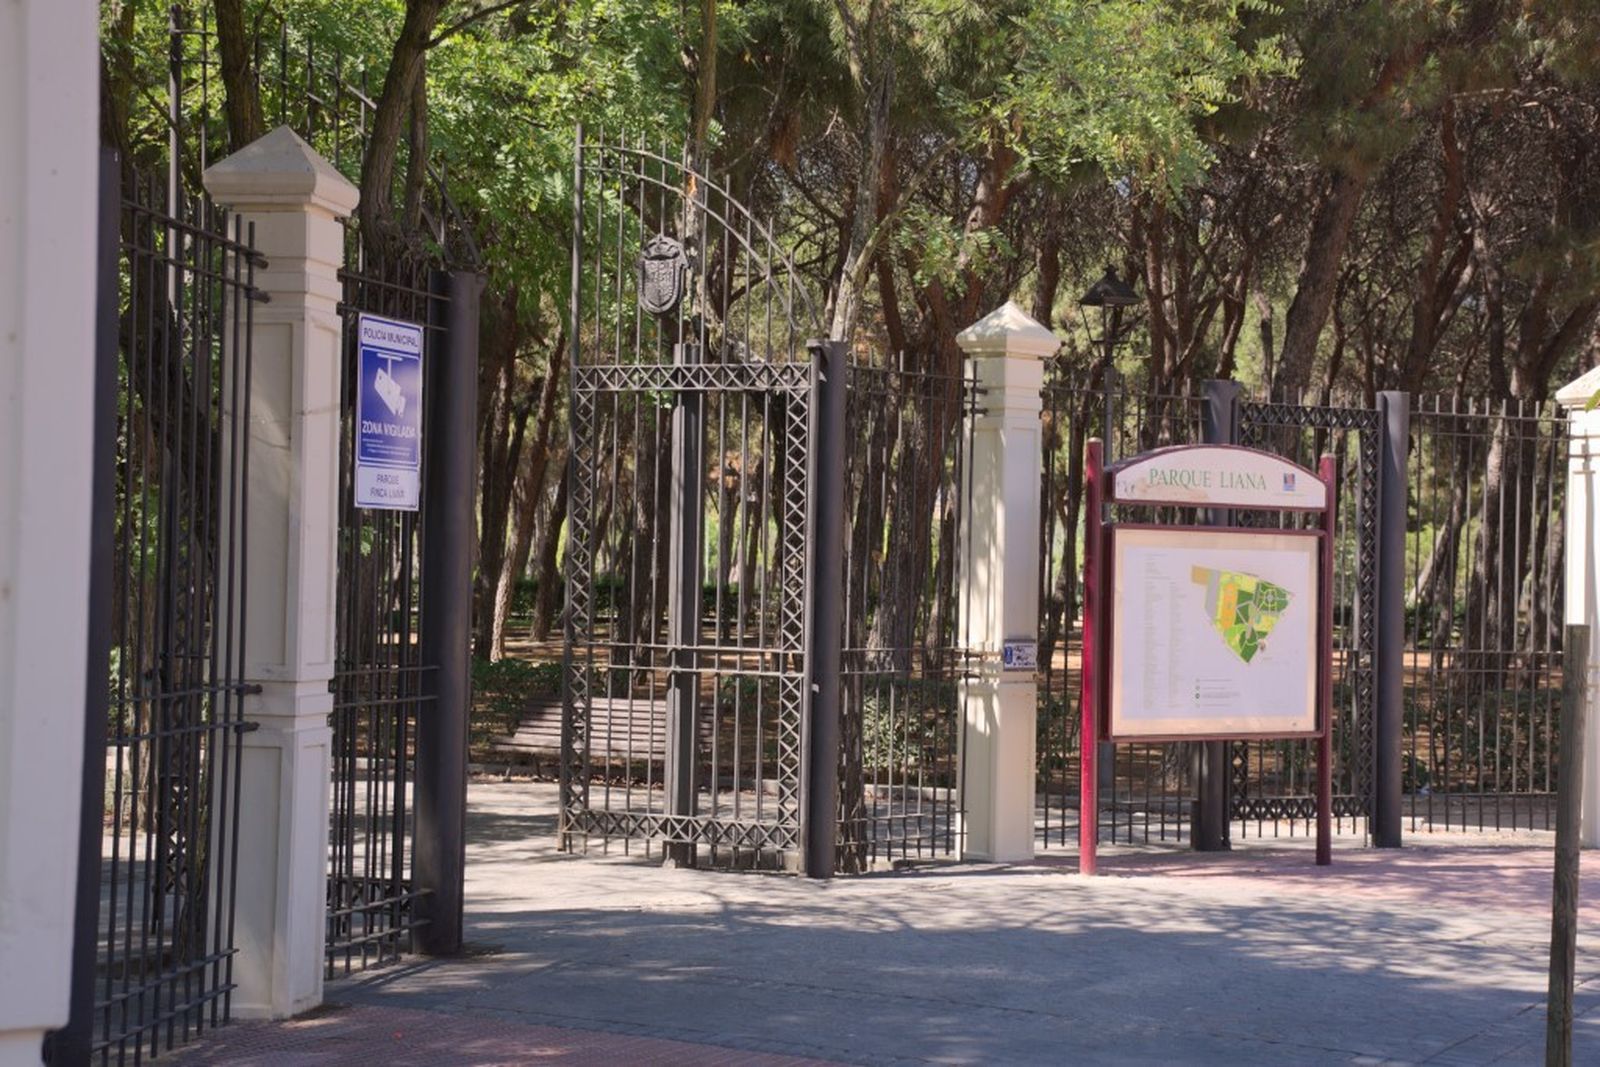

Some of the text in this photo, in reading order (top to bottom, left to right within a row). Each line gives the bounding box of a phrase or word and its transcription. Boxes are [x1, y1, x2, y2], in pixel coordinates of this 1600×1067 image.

[387, 332, 418, 347] MUNICIPAL
[362, 420, 416, 438] ZONA VIGILADA
[1150, 468, 1211, 489] PARQUE
[1220, 471, 1267, 490] LIANA
